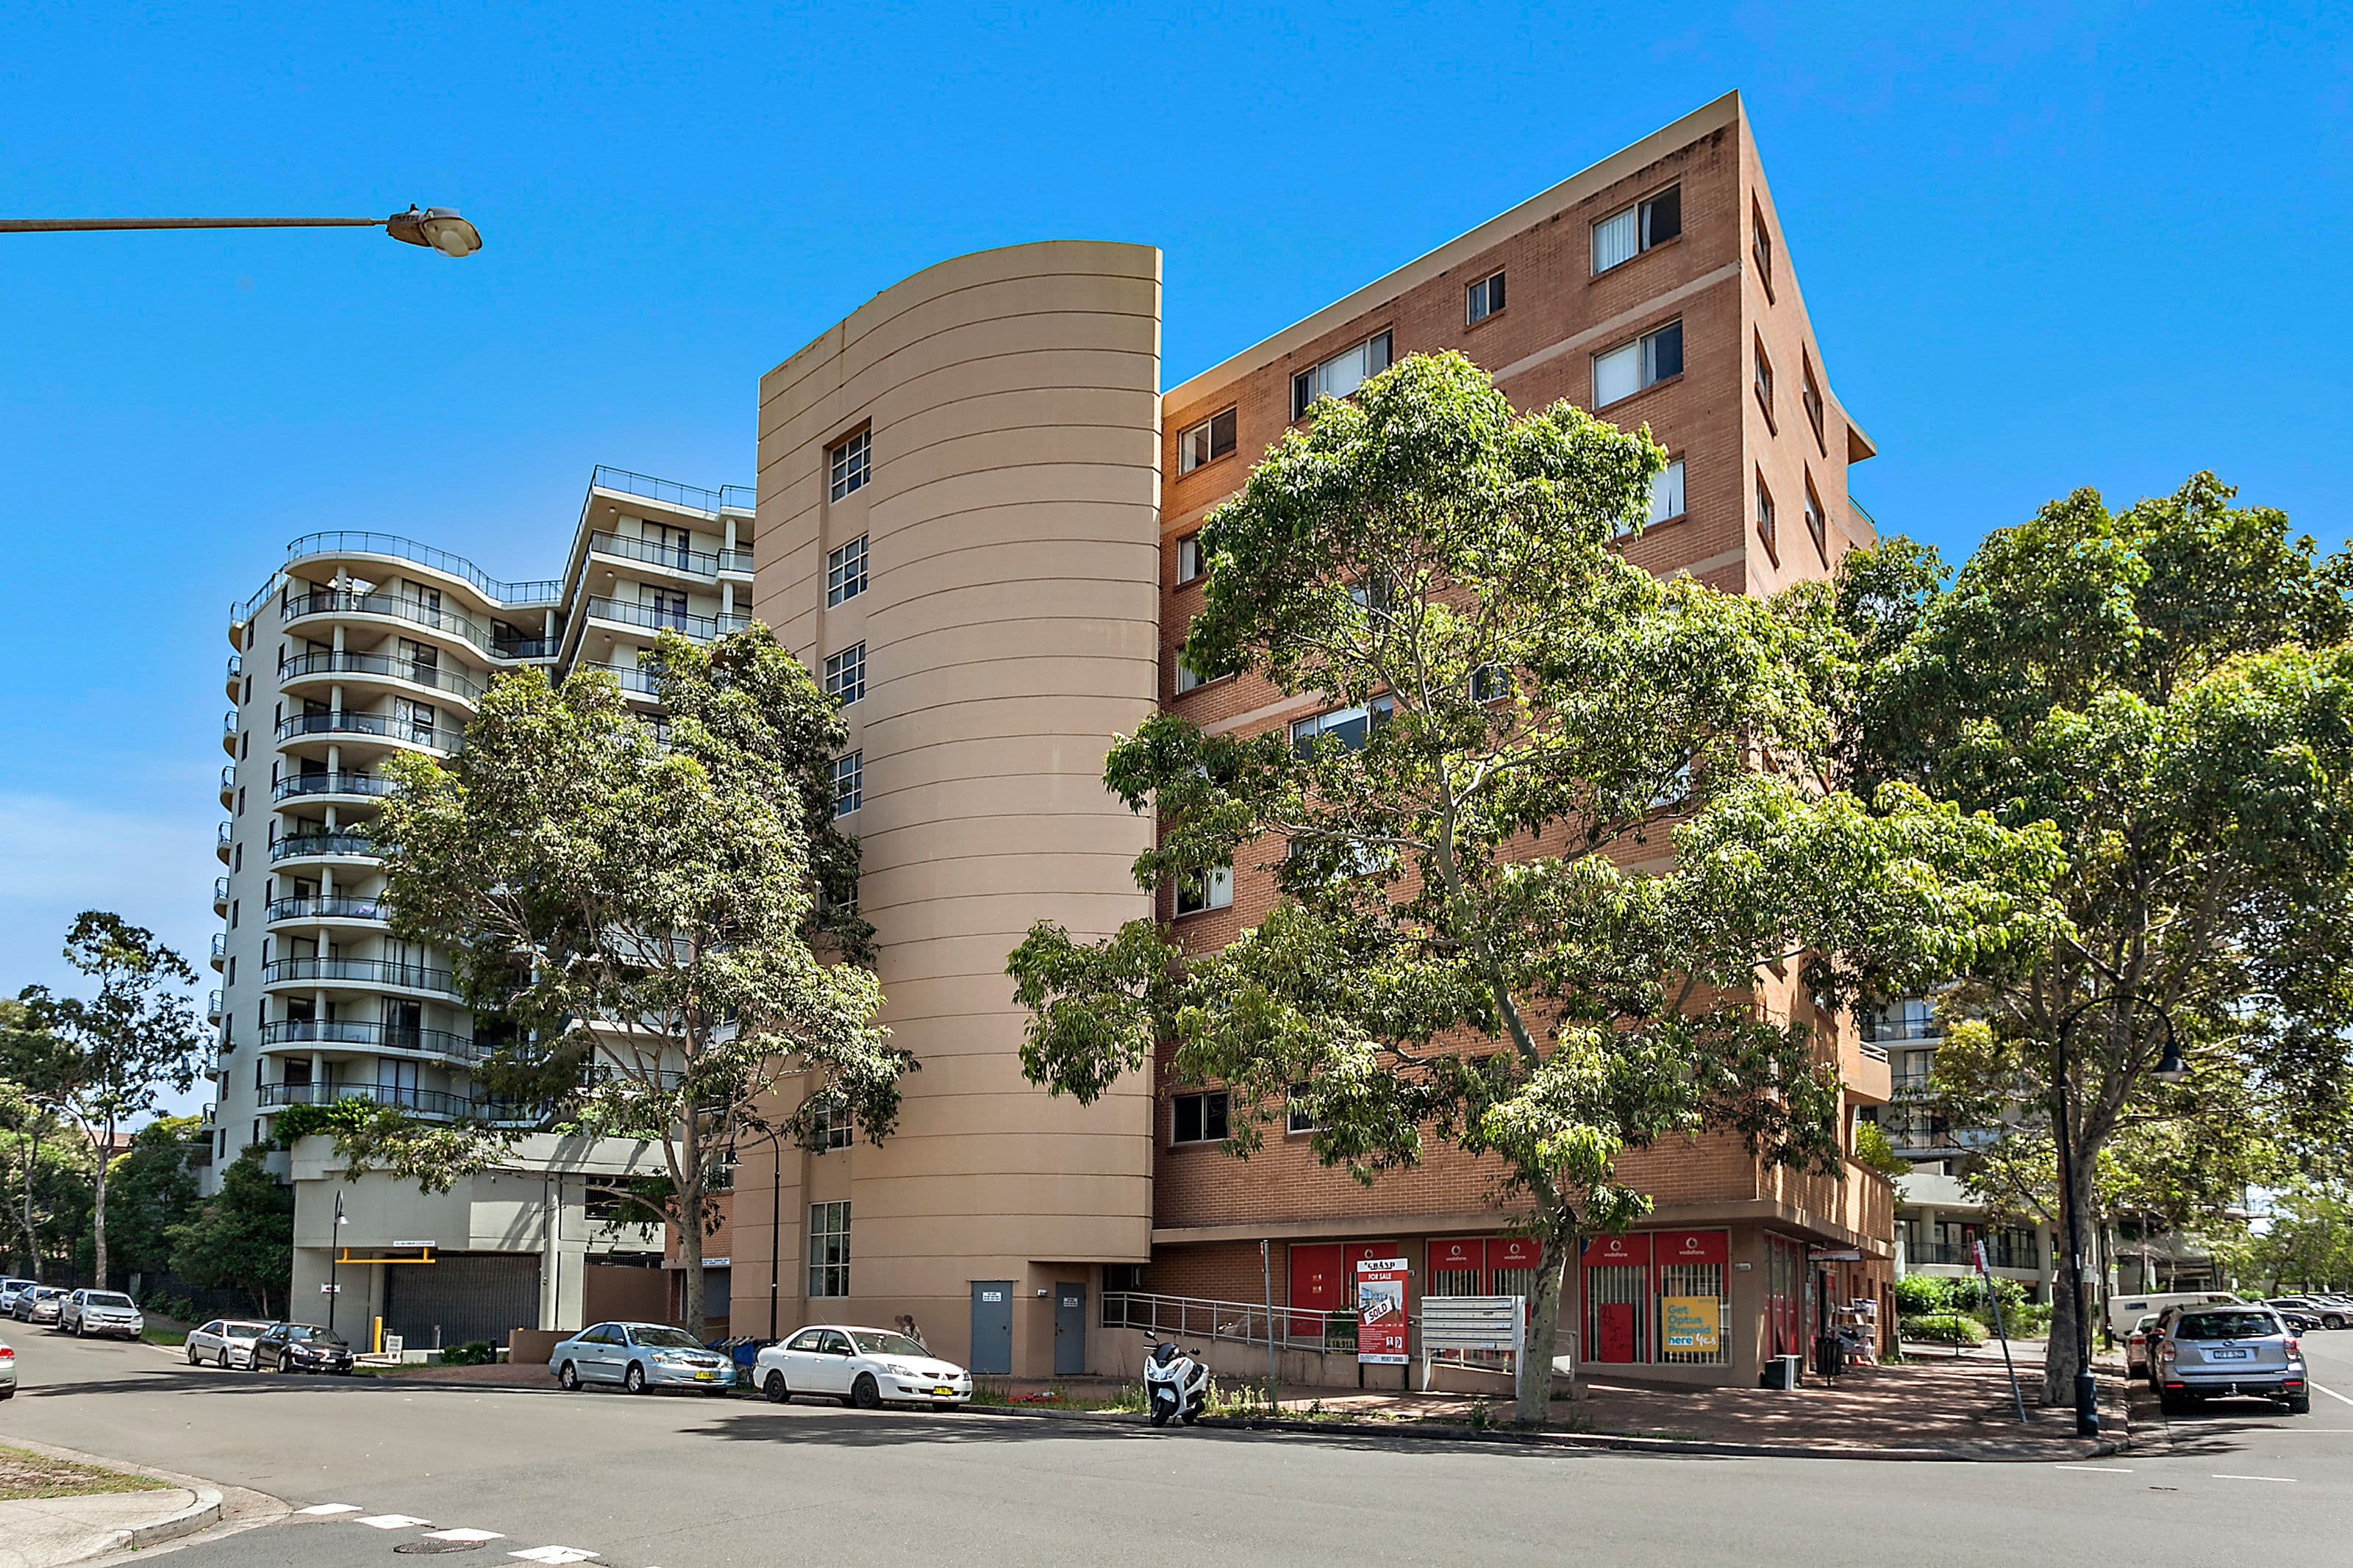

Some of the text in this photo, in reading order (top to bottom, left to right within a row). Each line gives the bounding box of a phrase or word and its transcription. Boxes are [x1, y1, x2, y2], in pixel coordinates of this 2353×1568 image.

[1368, 1303, 1388, 1321] SOLD
[1668, 1305, 1689, 1314] Get
[1668, 1315, 1702, 1325] Optus
[1668, 1325, 1711, 1335] Prepaid
[1668, 1336, 1693, 1345] here
